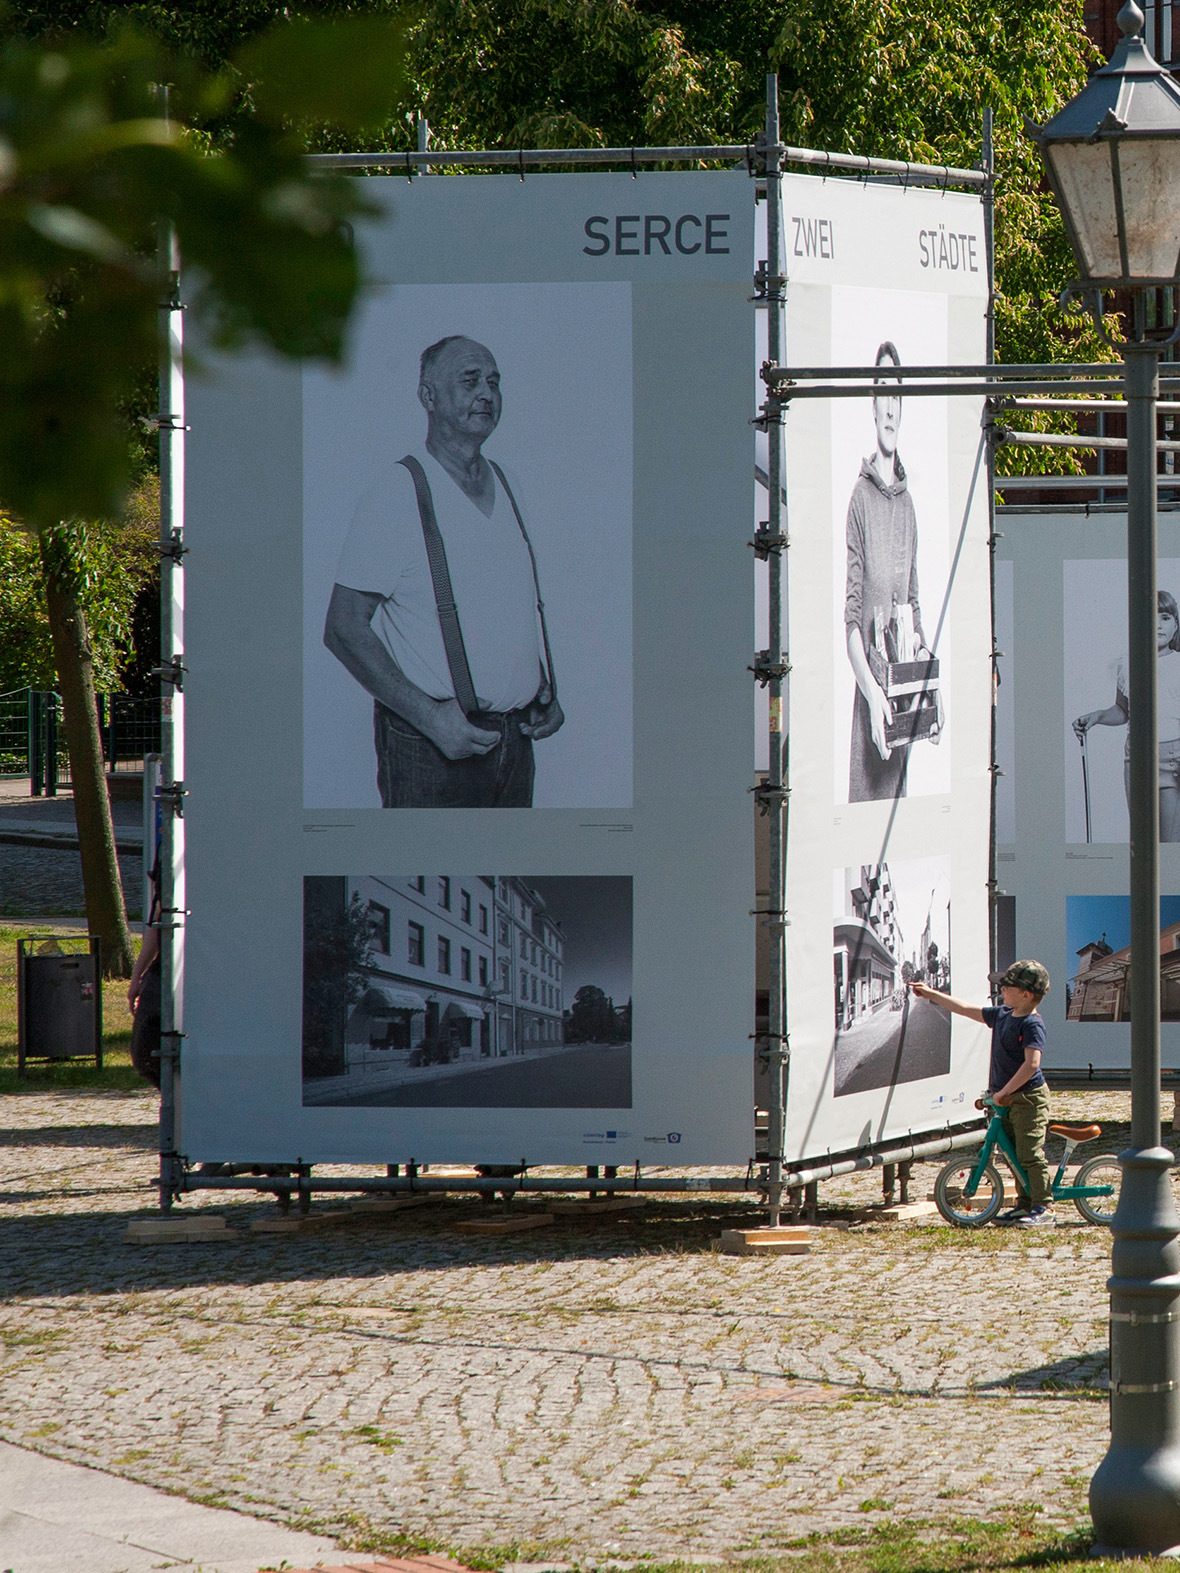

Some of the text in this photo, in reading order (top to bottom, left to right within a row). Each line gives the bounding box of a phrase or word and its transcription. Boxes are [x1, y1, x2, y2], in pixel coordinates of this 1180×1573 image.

[582, 214, 731, 257] SERCE
[791, 216, 979, 273] ZWEI STÄDTE
